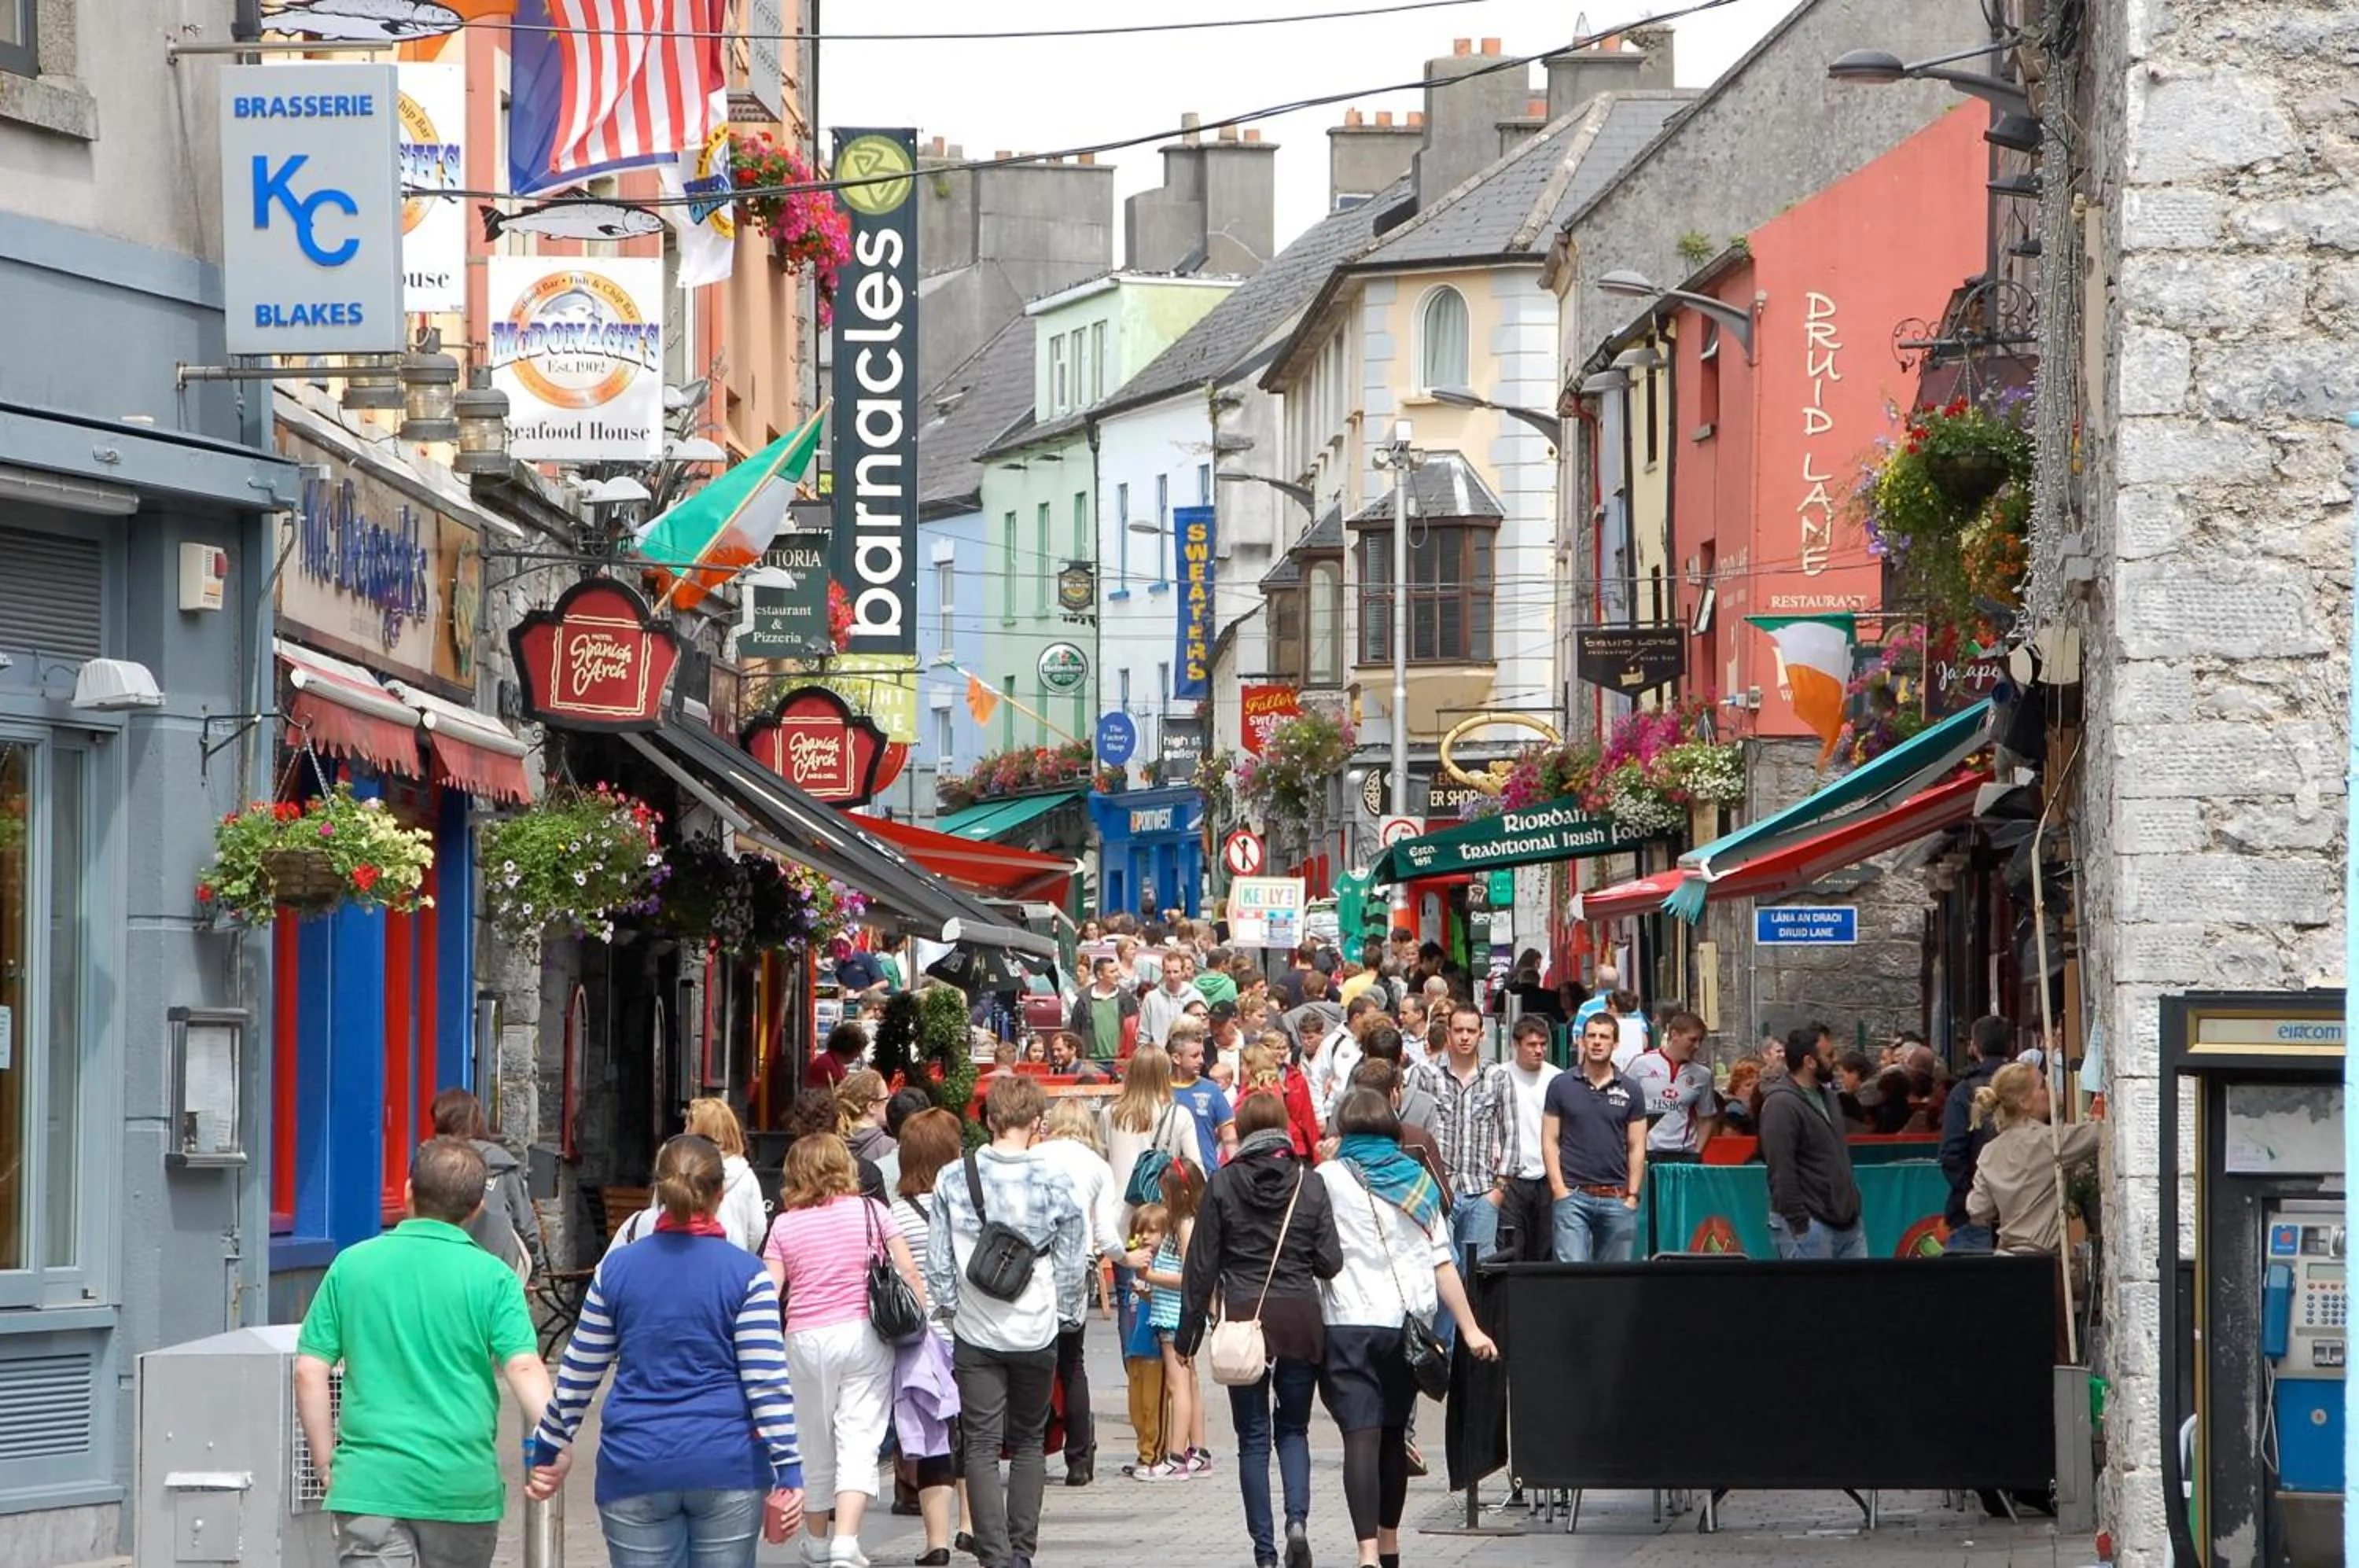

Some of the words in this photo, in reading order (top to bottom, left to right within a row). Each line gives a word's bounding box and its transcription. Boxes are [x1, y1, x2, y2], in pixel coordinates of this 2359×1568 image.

[234, 94, 374, 119] BRASSERIE
[252, 154, 360, 267] KC
[403, 271, 450, 289] use
[254, 302, 364, 328] BLAKES
[576, 360, 605, 374] 1902
[1801, 291, 1843, 435] DRUID
[513, 421, 582, 441] eafood
[590, 421, 651, 441] House
[844, 228, 904, 637] barnacles
[1796, 453, 1834, 576] LANE
[754, 549, 822, 568] ATTORIA
[754, 605, 812, 617] estaurant
[1184, 523, 1209, 681] SWEATERS
[1771, 594, 1868, 608] RESTAURANT
[771, 617, 783, 631] &
[753, 631, 802, 643] Pizzeria
[569, 634, 632, 669] Spanish
[572, 658, 627, 696] Arch
[789, 731, 840, 762] Spanish
[1163, 735, 1189, 748] high
[793, 751, 837, 783] Arch
[1797, 913, 1811, 923] AN
[1778, 927, 1808, 937] DRUID
[1809, 927, 1835, 937] LANE
[1653, 1099, 1683, 1112] HSBC
